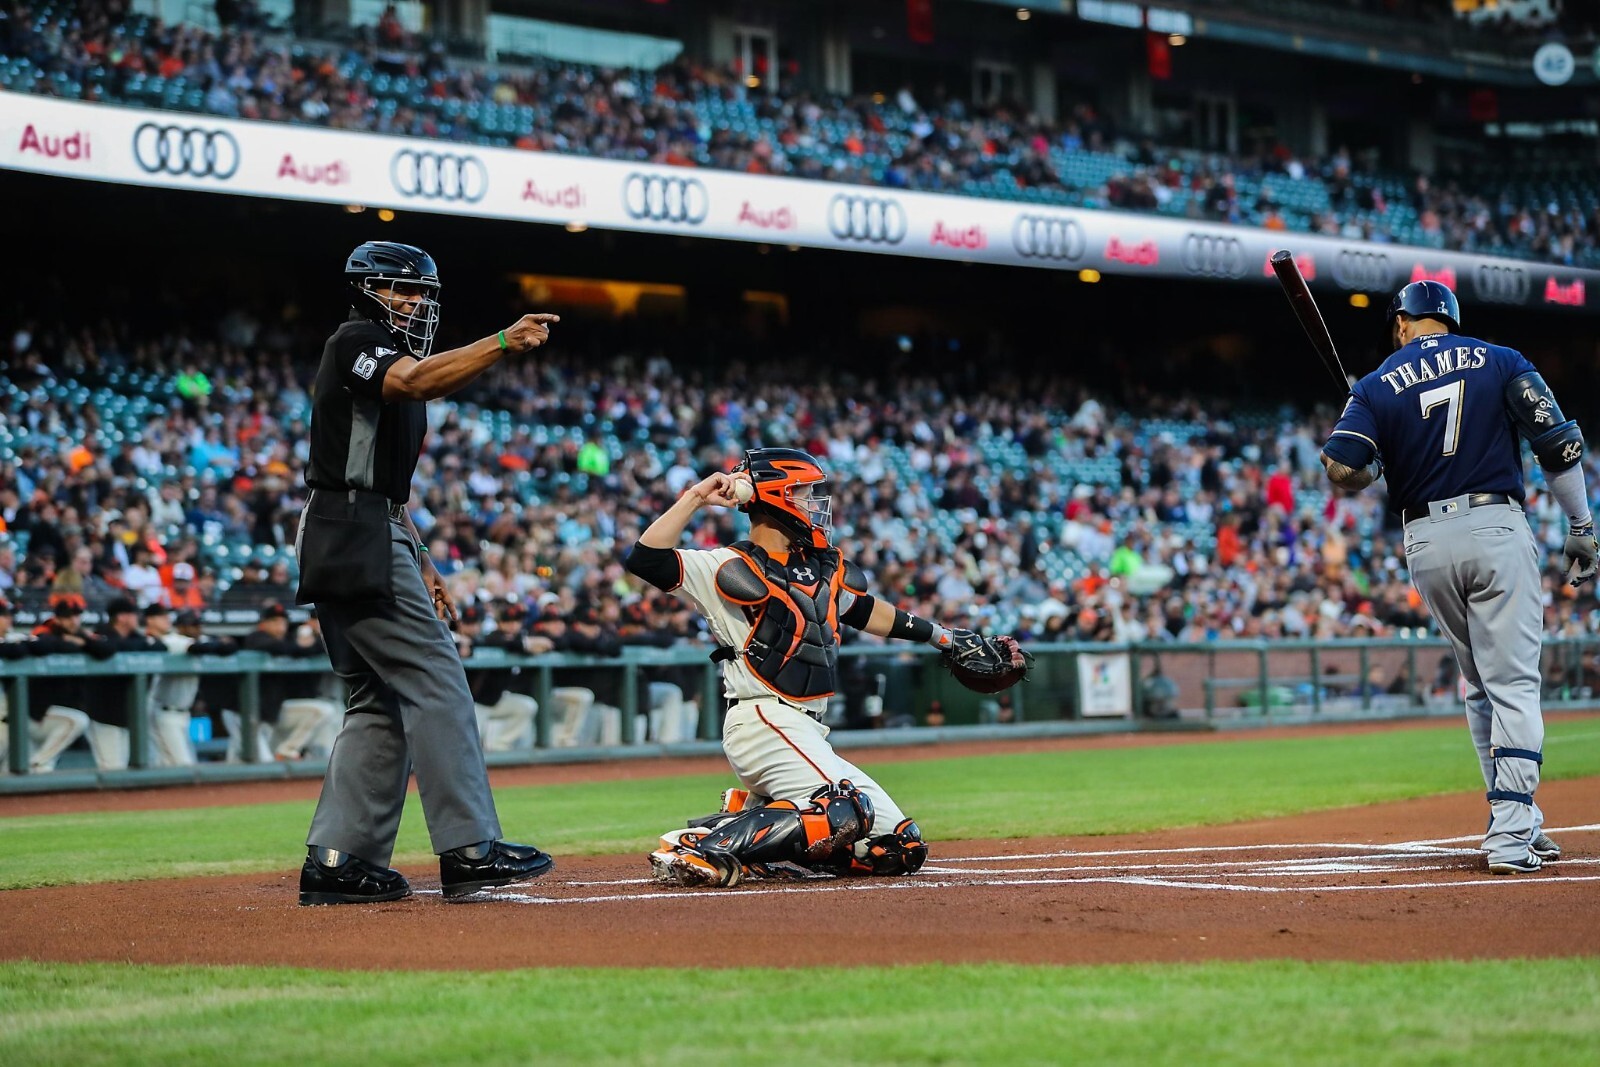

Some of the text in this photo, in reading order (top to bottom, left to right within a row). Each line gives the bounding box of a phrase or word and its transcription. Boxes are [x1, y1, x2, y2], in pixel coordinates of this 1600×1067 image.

[20, 123, 91, 161] Audi
[278, 153, 350, 187] Audi
[522, 178, 586, 209] Audi
[738, 201, 796, 230] Audi
[931, 220, 987, 250] Audi
[1104, 238, 1159, 267] Audi
[1544, 277, 1585, 305] Audi
[1381, 347, 1487, 395] THAMES
[1420, 379, 1465, 456] 7
